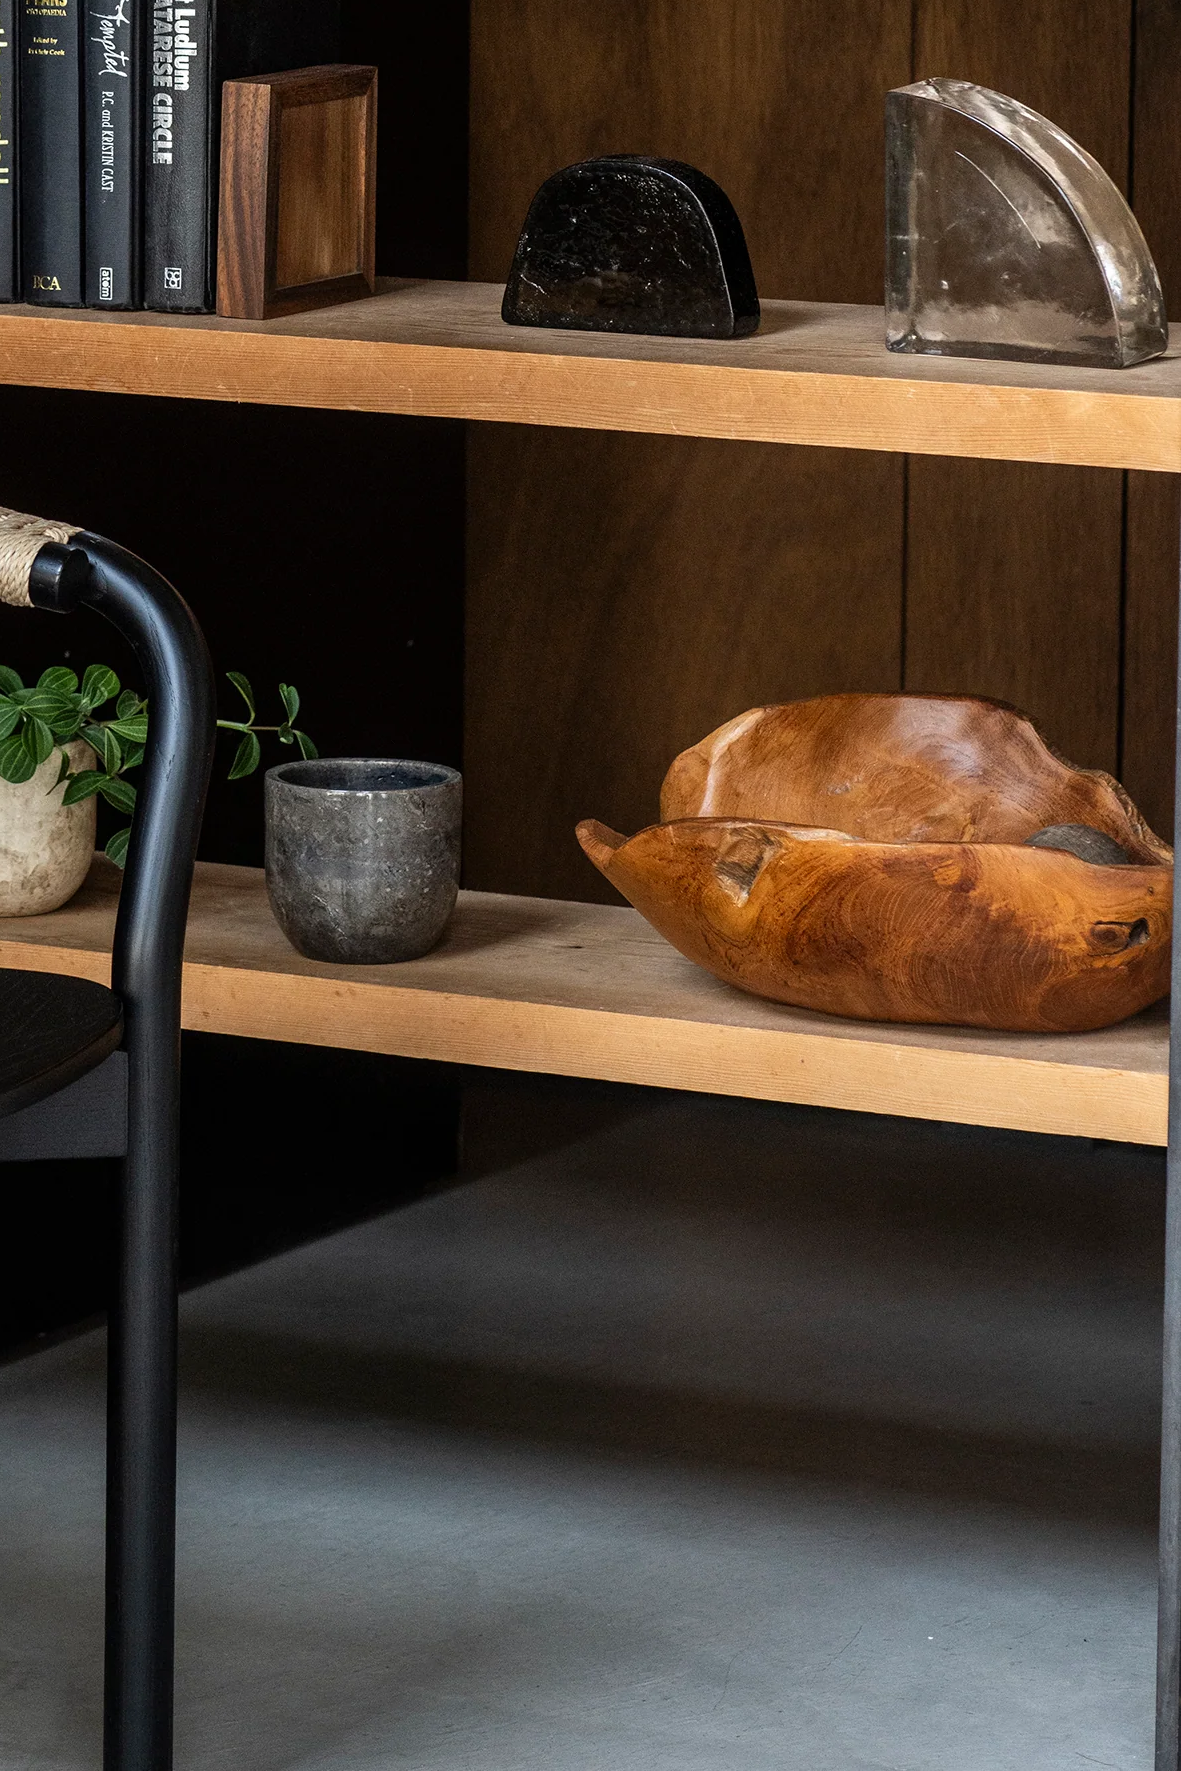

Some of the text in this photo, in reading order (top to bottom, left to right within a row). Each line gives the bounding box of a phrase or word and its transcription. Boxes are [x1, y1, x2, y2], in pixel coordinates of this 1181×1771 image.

[175, 9, 197, 91] Ludlum
[102, 91, 114, 192] P.C. and KRISTIN CAST
[152, 92, 173, 164] CIRCLE
[33, 275, 61, 291] BCA
